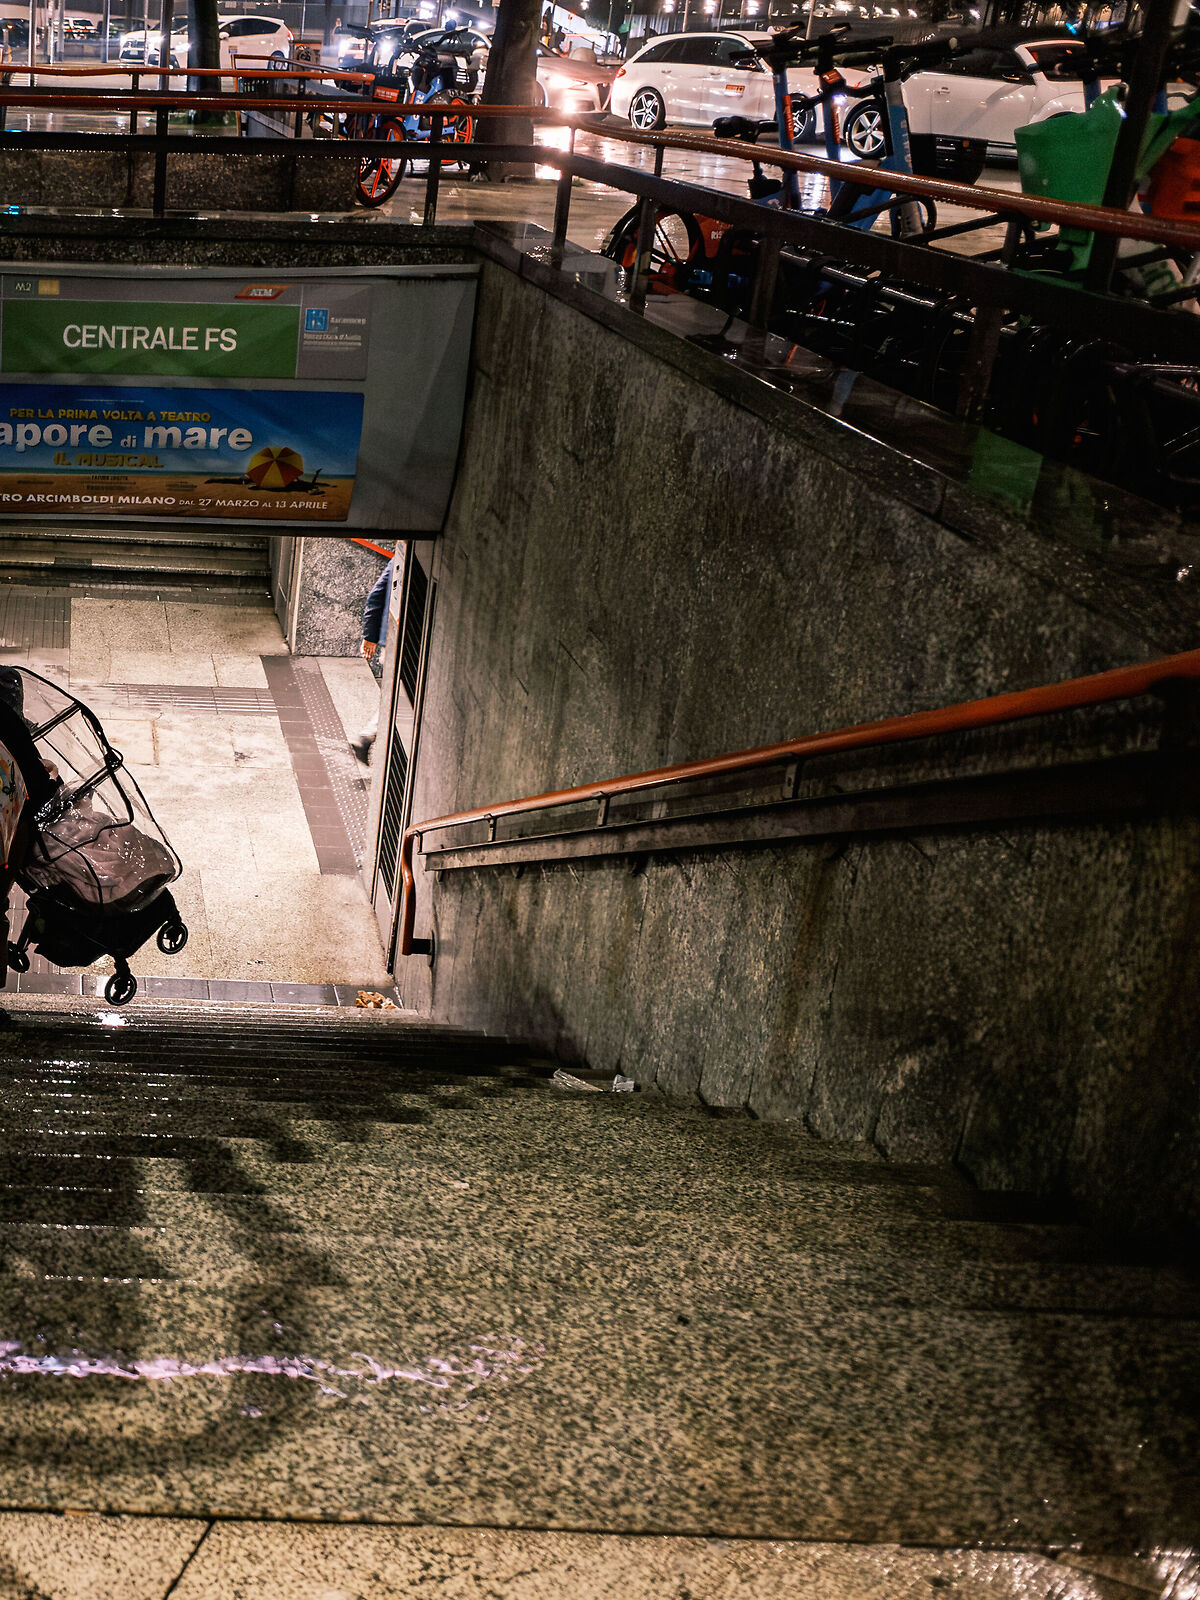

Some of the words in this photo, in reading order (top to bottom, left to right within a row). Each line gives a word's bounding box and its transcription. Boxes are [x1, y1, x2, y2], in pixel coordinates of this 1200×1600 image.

[15, 282, 32, 292] M2
[63, 324, 199, 350] CENTRALE
[204, 327, 238, 352] FS
[9, 408, 35, 419] PER
[37, 408, 55, 420] LA
[58, 409, 98, 420] PRIMA
[102, 410, 142, 421] VOLTA
[146, 410, 157, 421] A
[160, 411, 212, 423] TEATRO
[120, 435, 137, 448] di
[143, 425, 253, 451] mare
[53, 451, 72, 467] IL
[76, 452, 164, 469] MUSICAL
[26, 493, 114, 504] ARCIMBOLDI
[117, 495, 176, 505] MILANO
[198, 498, 212, 506] 27
[215, 499, 260, 508] MARZO
[275, 500, 287, 509] 13
[289, 501, 329, 510] APRILE
